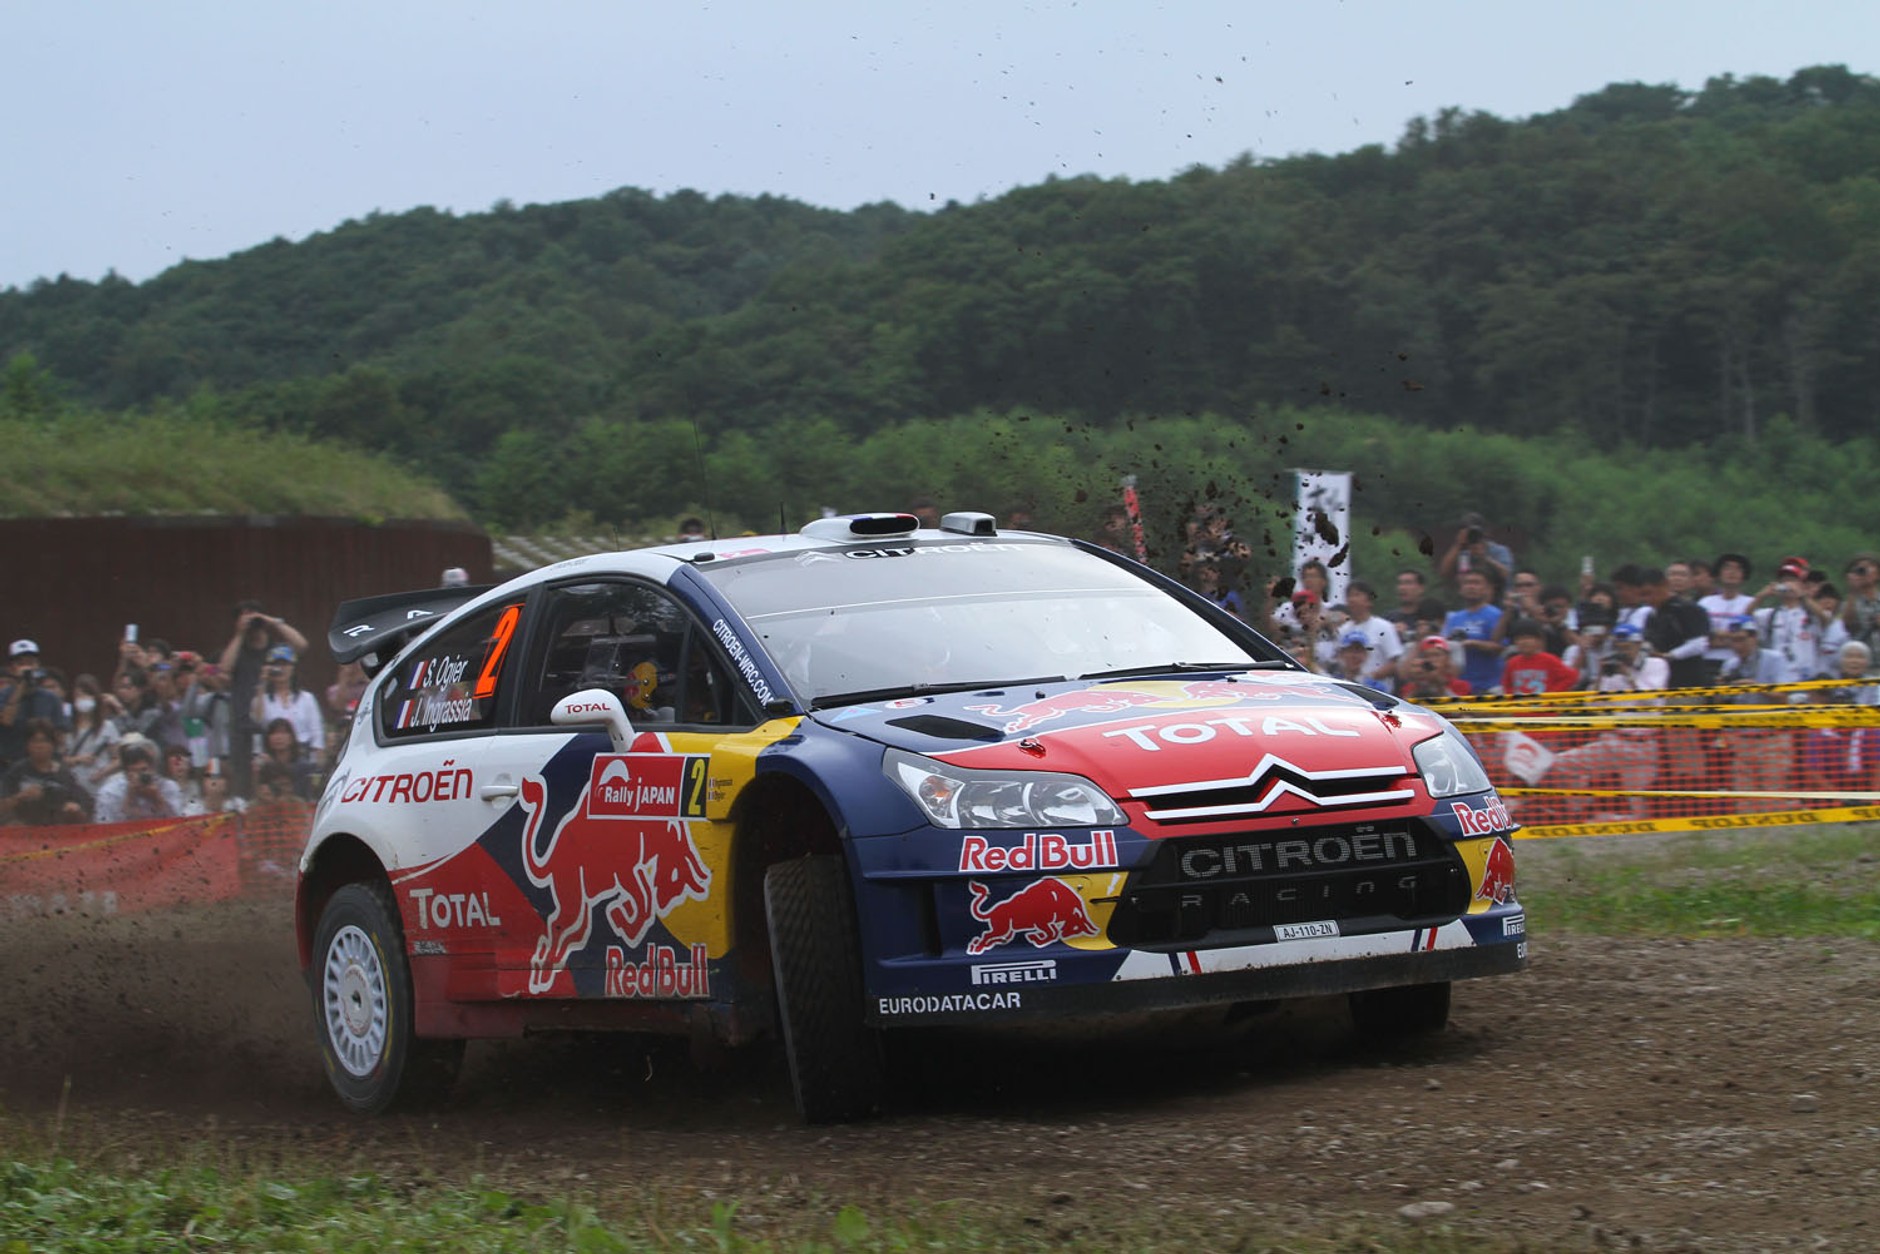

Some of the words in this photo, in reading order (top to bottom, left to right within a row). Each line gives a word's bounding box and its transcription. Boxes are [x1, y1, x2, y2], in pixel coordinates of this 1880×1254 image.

[474, 605, 521, 696] 2
[713, 618, 774, 706] CITROEN-WRC.COM
[423, 658, 434, 688] S.
[435, 654, 468, 691] Ogier
[410, 700, 421, 728] J.
[422, 692, 473, 732] Ingrassia
[565, 703, 611, 714] TOTAL
[1102, 716, 1361, 752] TOTAL
[604, 786, 634, 807] Rally
[688, 758, 705, 815] 2
[1450, 796, 1504, 837] Red
[959, 833, 1036, 872] Red
[1039, 830, 1119, 870] Bull
[409, 888, 501, 929] TOTAL
[1283, 923, 1333, 939] AJ-110-ZN
[605, 942, 656, 998] Red
[657, 942, 710, 998] Bull
[971, 959, 1057, 985] PIRELLI
[879, 992, 1021, 1014] EURODATACAR
